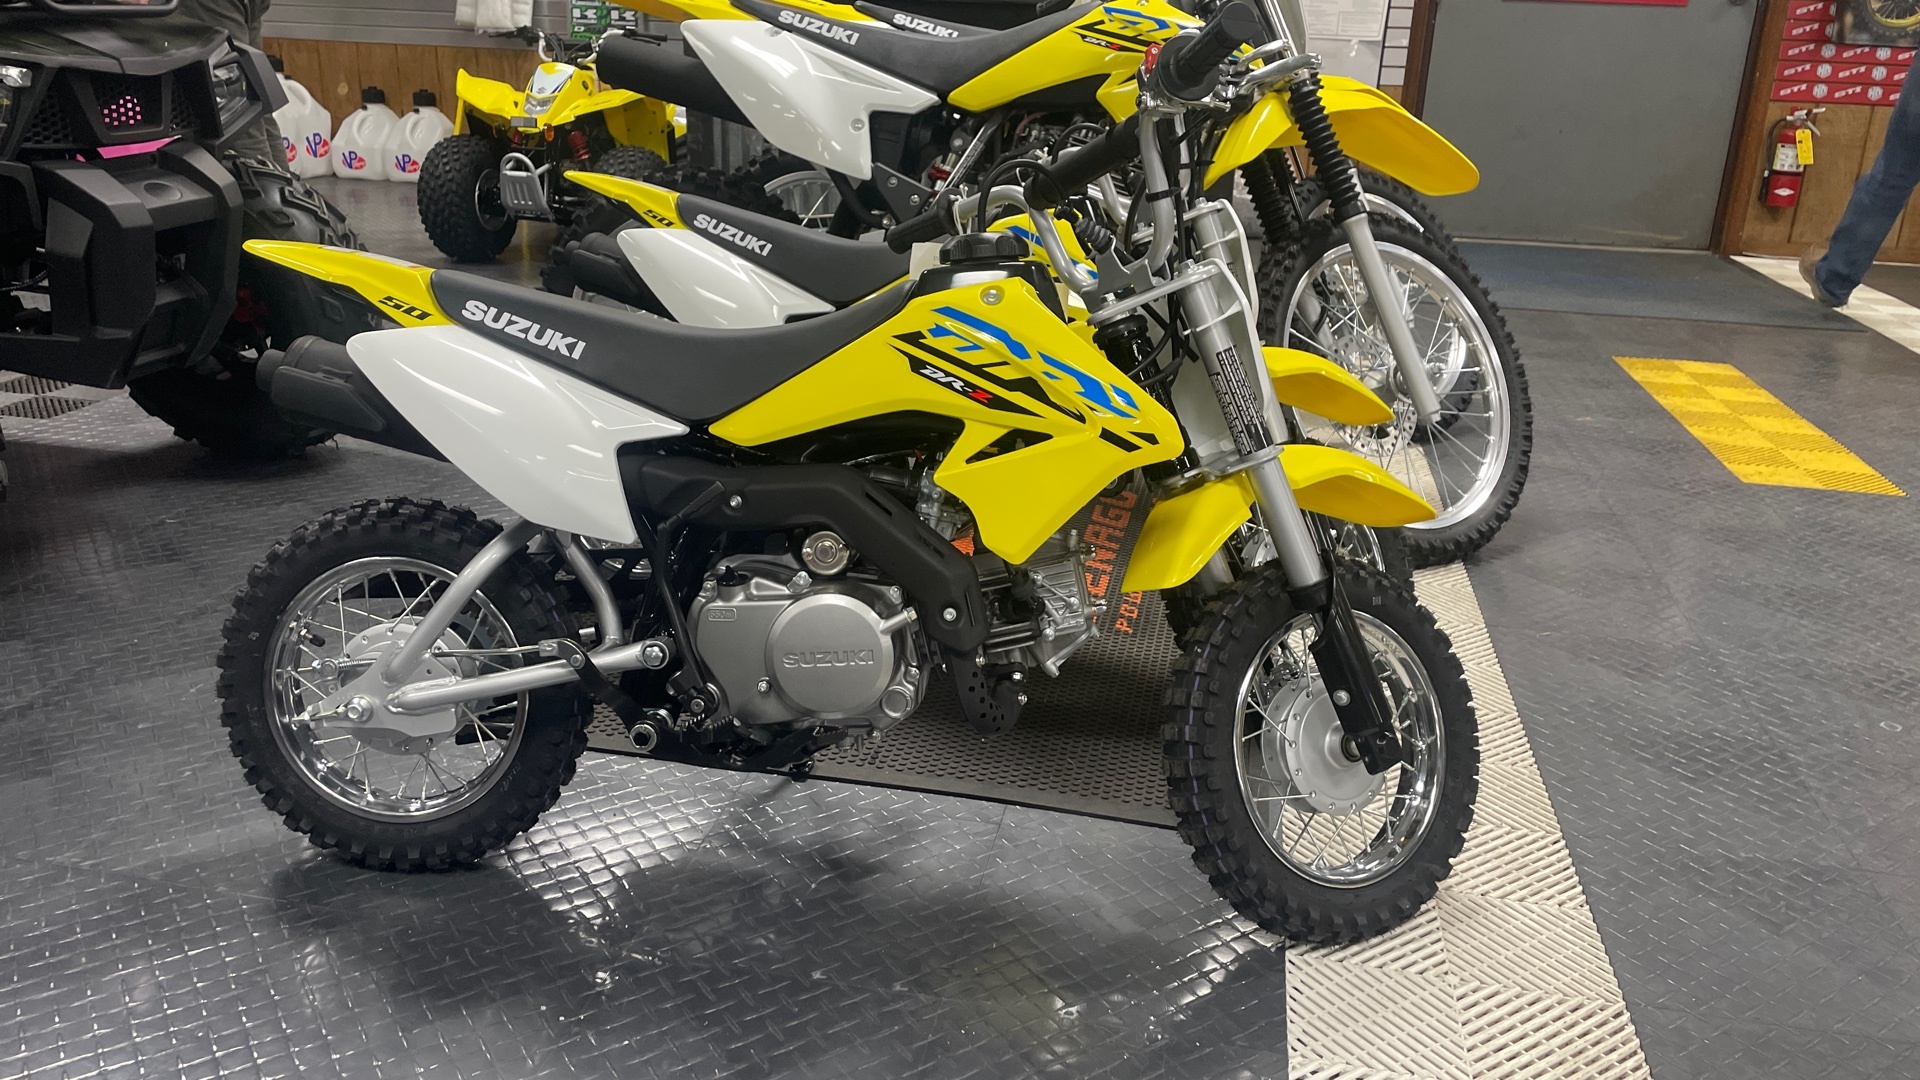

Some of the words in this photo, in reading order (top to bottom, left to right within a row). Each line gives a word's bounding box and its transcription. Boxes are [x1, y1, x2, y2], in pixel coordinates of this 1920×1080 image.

[1796, 2, 1824, 15] STI
[778, 10, 860, 46] SUZUKI
[893, 13, 959, 38] SUZUKI
[1791, 22, 1820, 36] STI
[1787, 43, 1816, 56] STI
[1842, 46, 1870, 58] STI
[1783, 63, 1812, 76] STI
[1838, 65, 1867, 78] STI
[1780, 83, 1808, 96] STI
[1834, 86, 1862, 98] STI
[305, 133, 322, 158] VP
[342, 151, 358, 169] VP
[395, 154, 412, 172] VP
[642, 209, 676, 227] 50
[693, 213, 773, 257] SUZUKI
[377, 295, 433, 321] 50
[461, 300, 586, 360] SUZUKI
[919, 365, 993, 404] DR-Z
[783, 649, 875, 668] SUZUKI
